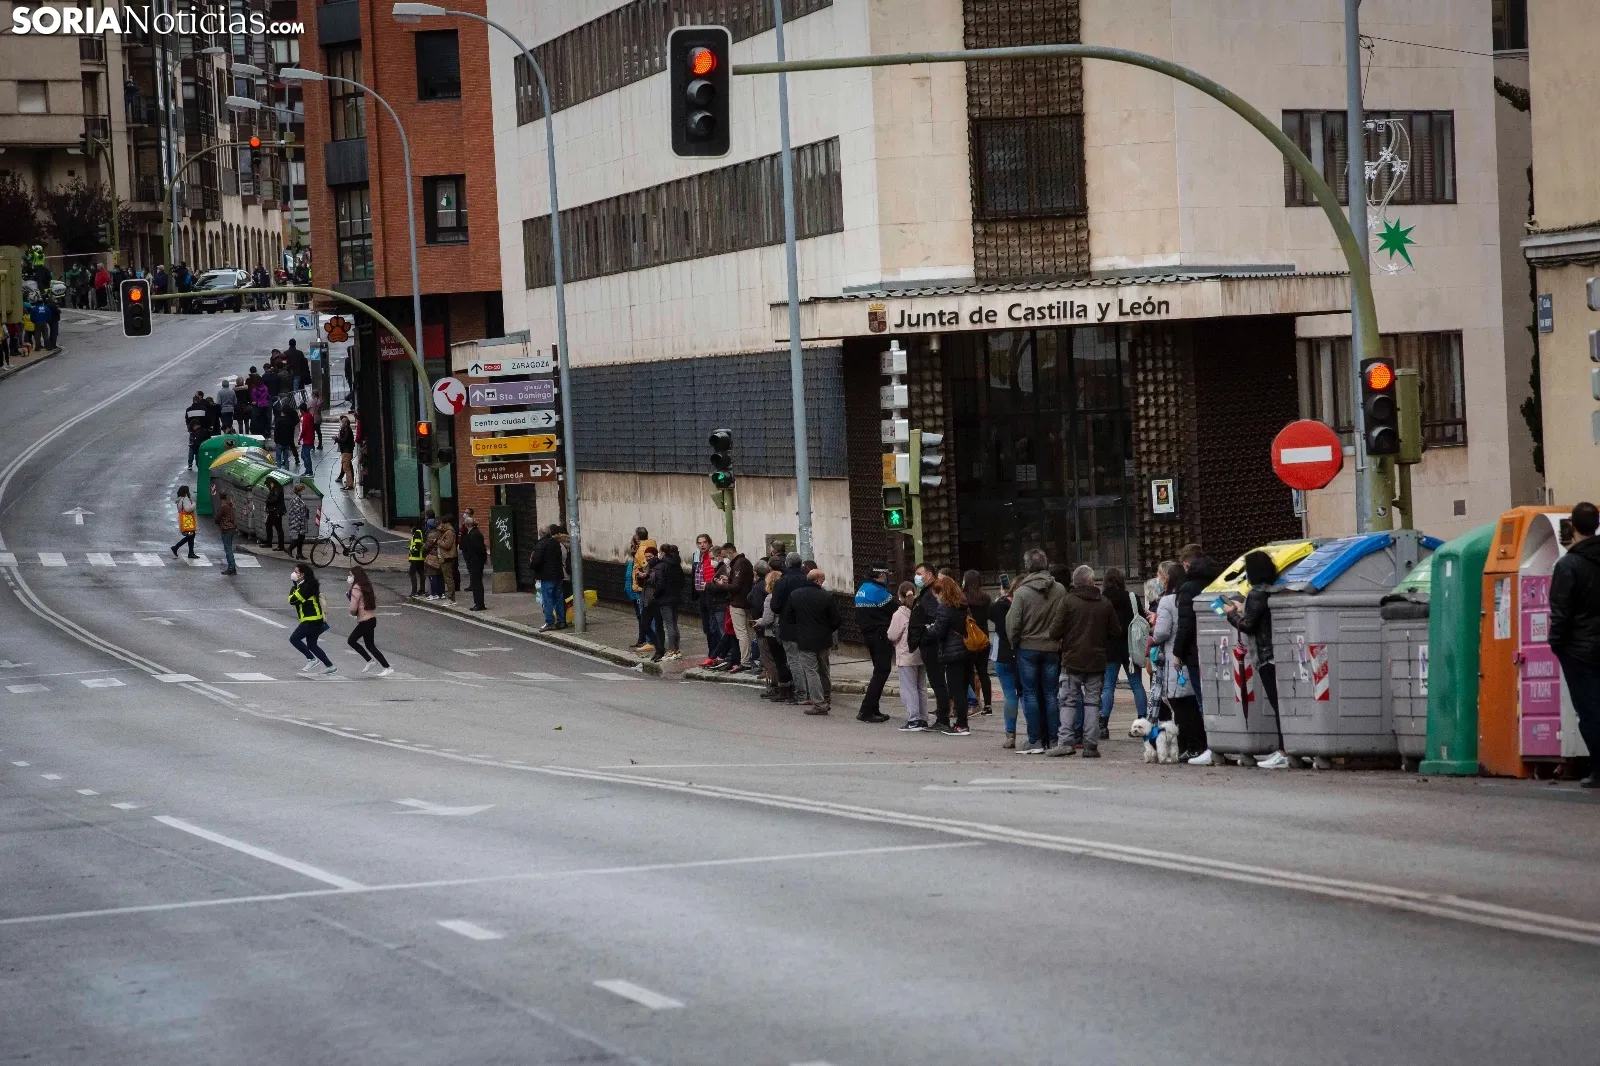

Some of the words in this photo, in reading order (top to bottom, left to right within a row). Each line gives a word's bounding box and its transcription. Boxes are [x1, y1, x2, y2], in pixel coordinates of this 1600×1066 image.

[894, 308, 960, 328] Junta
[969, 305, 998, 324] de
[1007, 300, 1088, 322] Castilla
[1097, 302, 1111, 322] y
[1118, 296, 1170, 317] León
[511, 362, 550, 370] ZARAGOZA
[518, 391, 551, 400] Domingo
[474, 419, 499, 427] centro
[501, 416, 526, 425] ciudad
[475, 442, 508, 450] Correos
[491, 472, 524, 480] Alameda
